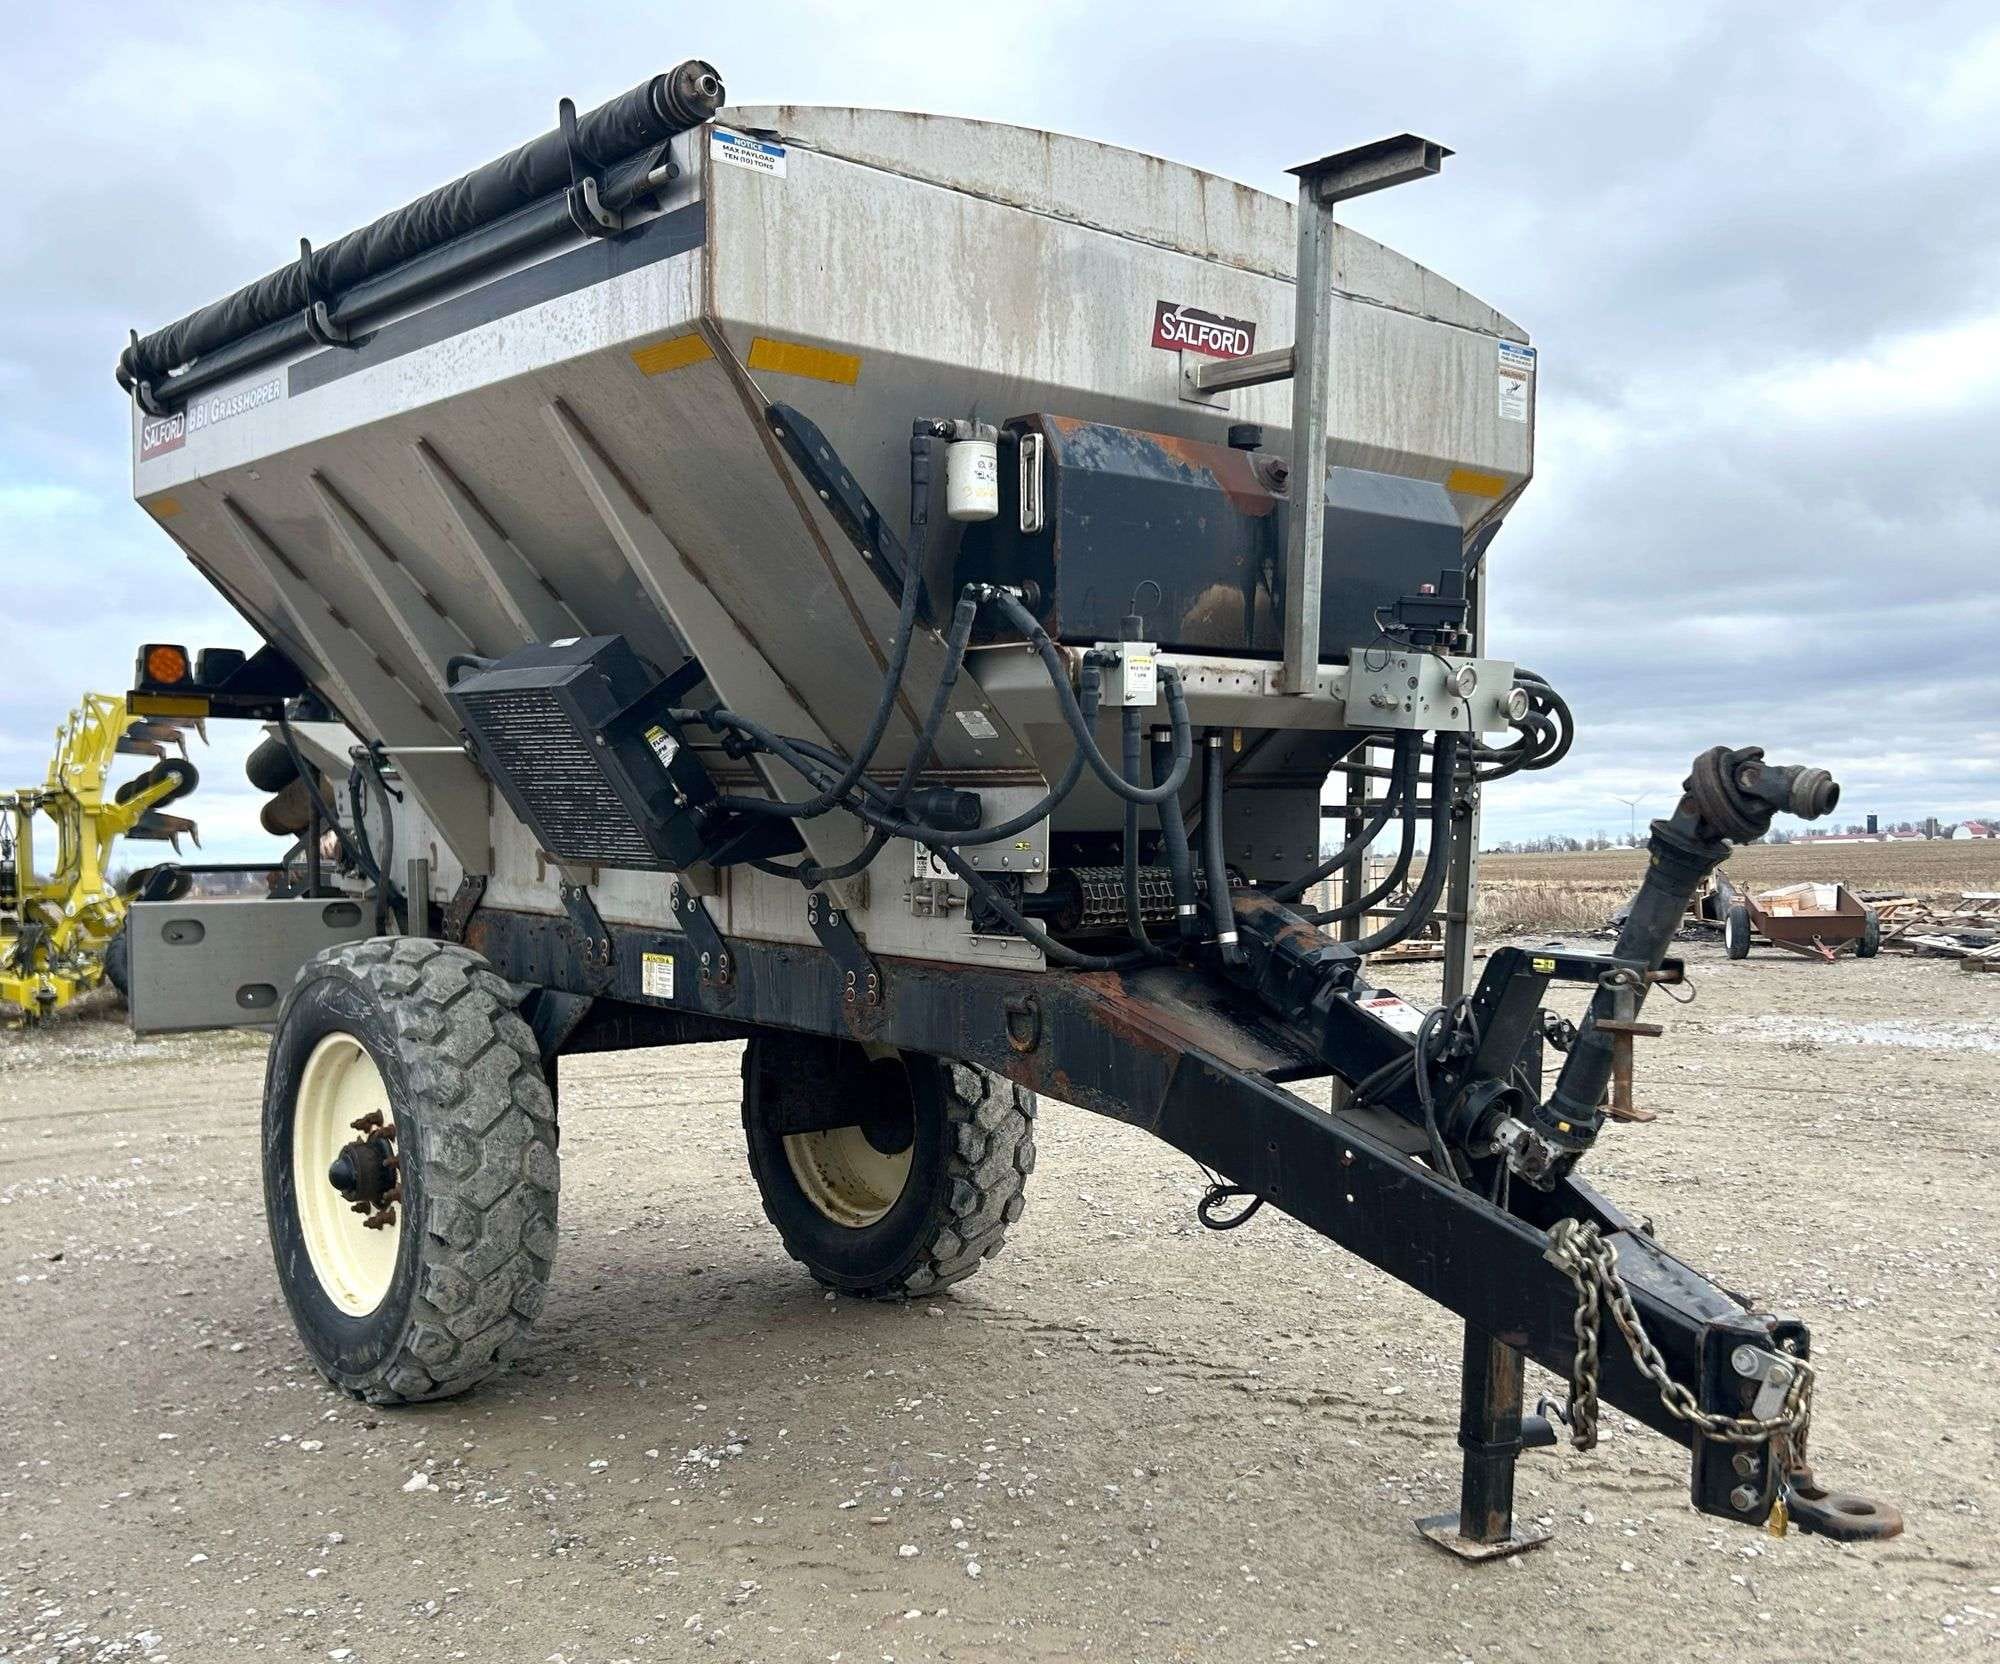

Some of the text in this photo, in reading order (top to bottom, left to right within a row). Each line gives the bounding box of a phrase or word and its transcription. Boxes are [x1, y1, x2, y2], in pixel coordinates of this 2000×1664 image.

[722, 144, 775, 163] MAX PAYLOAD
[734, 138, 763, 151] NOTICE
[724, 152, 774, 170] TEN (10) TONS
[1160, 312, 1249, 355] SALFORD
[143, 380, 281, 451] SALFORD BBI GRASSHOPPER
